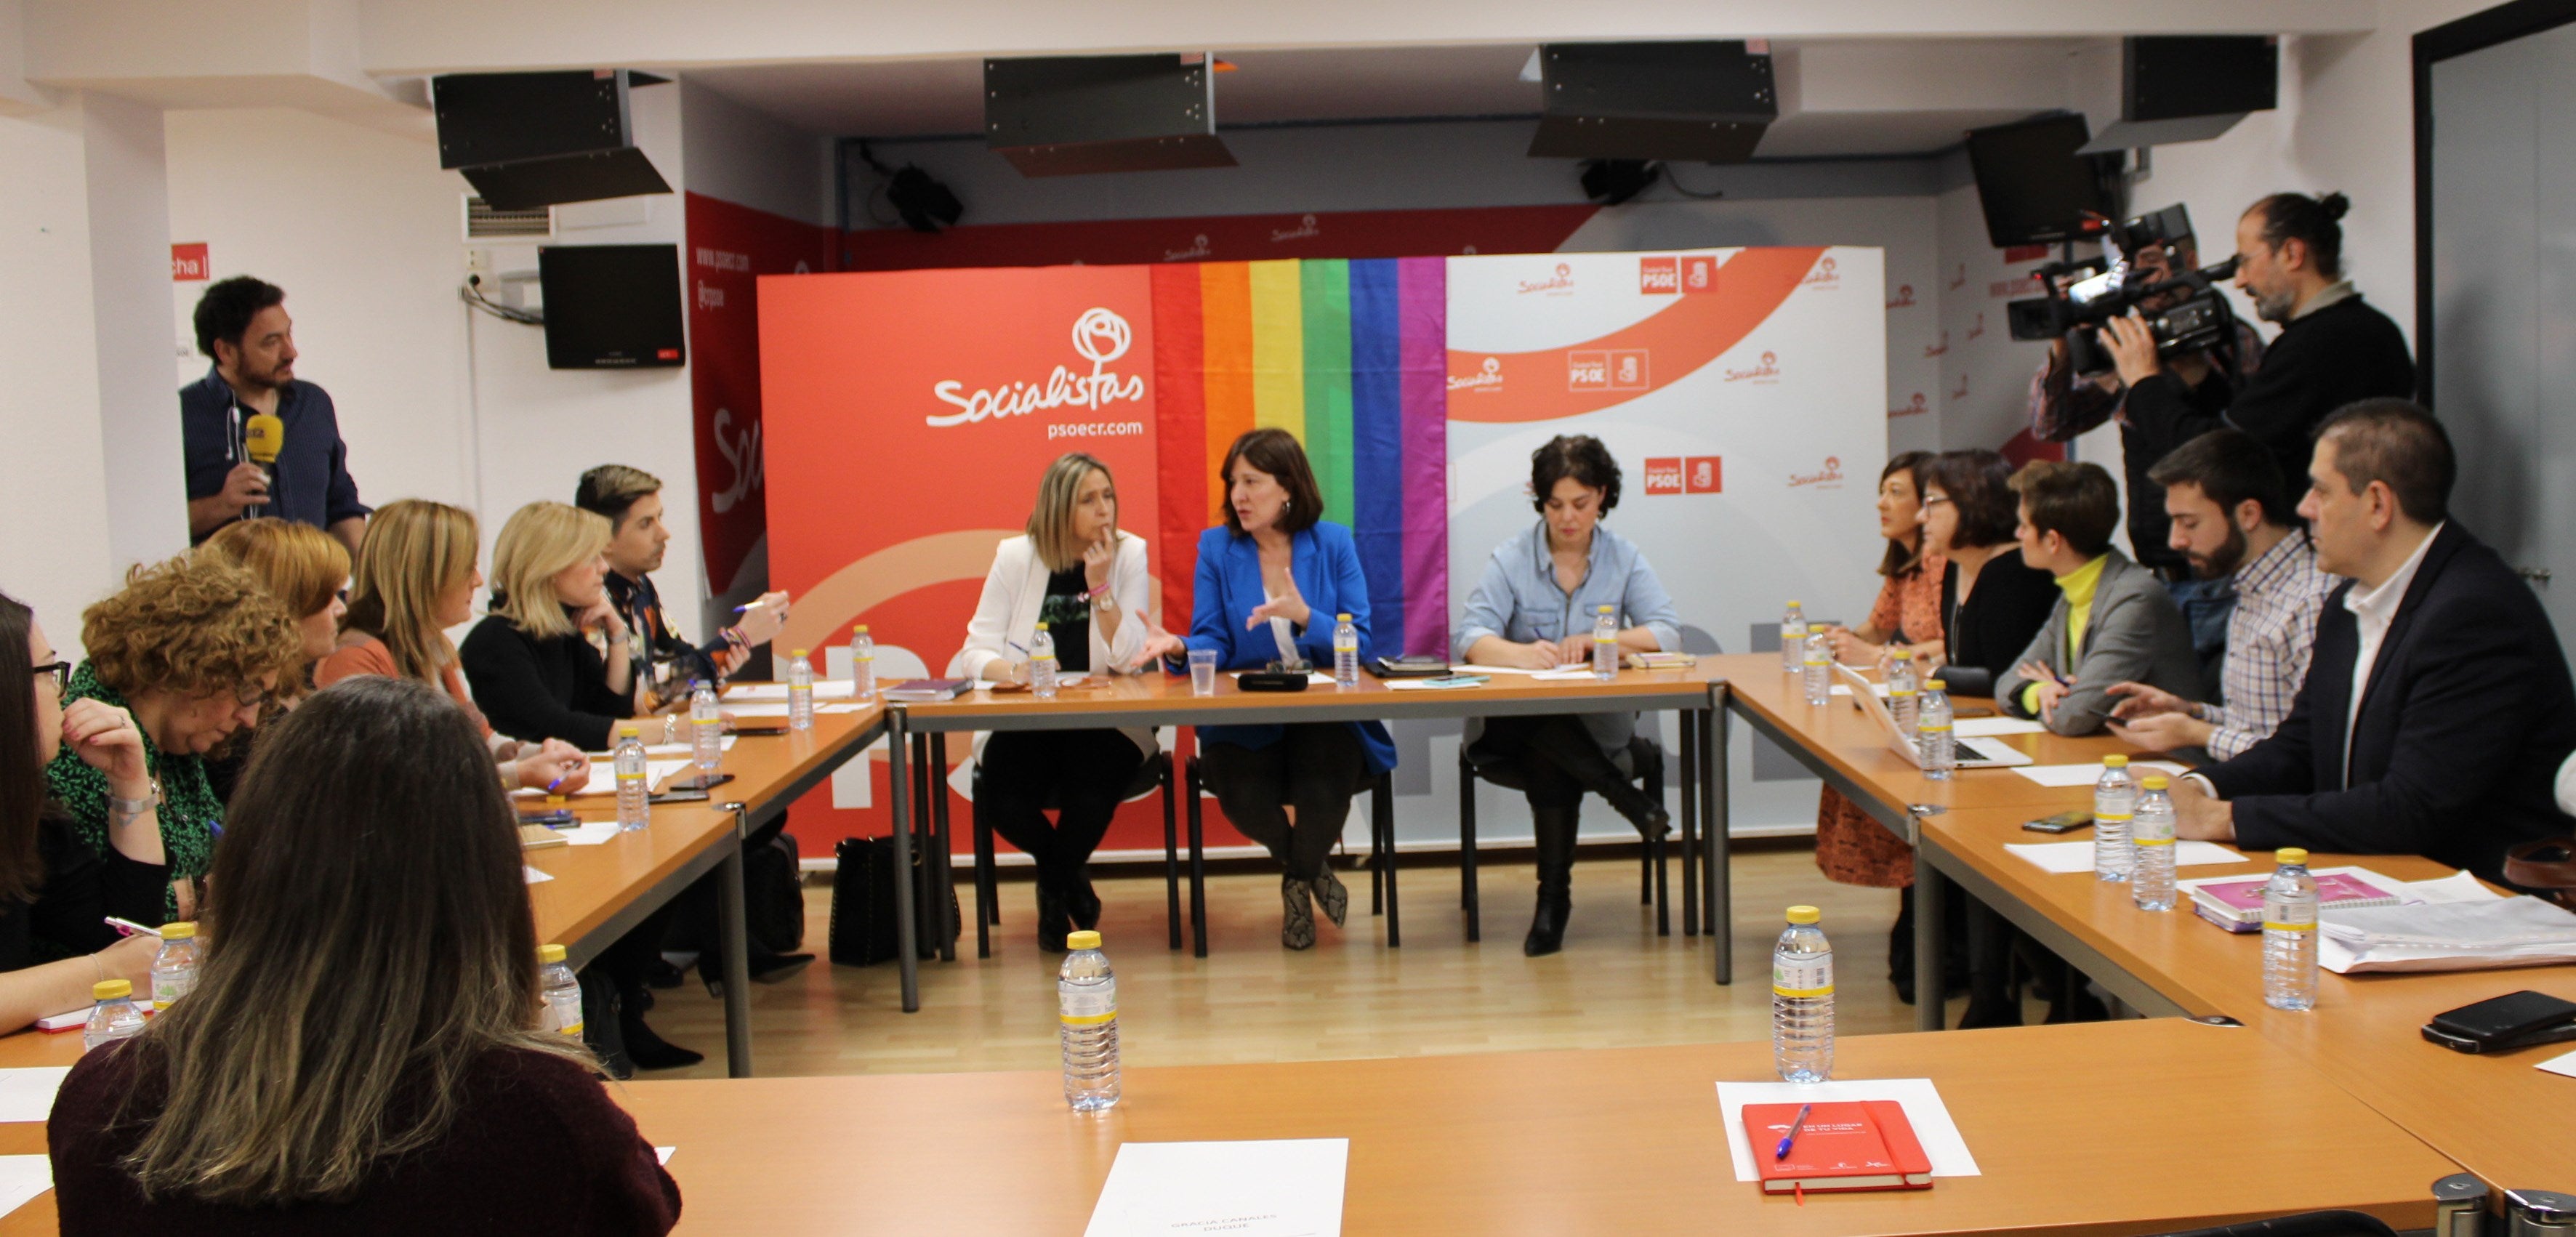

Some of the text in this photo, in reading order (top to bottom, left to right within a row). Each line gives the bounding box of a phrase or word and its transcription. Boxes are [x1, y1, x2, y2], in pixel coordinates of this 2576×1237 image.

[1643, 273, 1676, 289] PSOE
[1571, 368, 1605, 383] PSOE
[926, 361, 1144, 427] Socialistas
[1048, 421, 1143, 440] psoecr.com
[1646, 473, 1681, 488] PSOE
[1171, 1214, 1278, 1228] GRACIA CANALES
[1204, 1222, 1250, 1233] DUQUE
